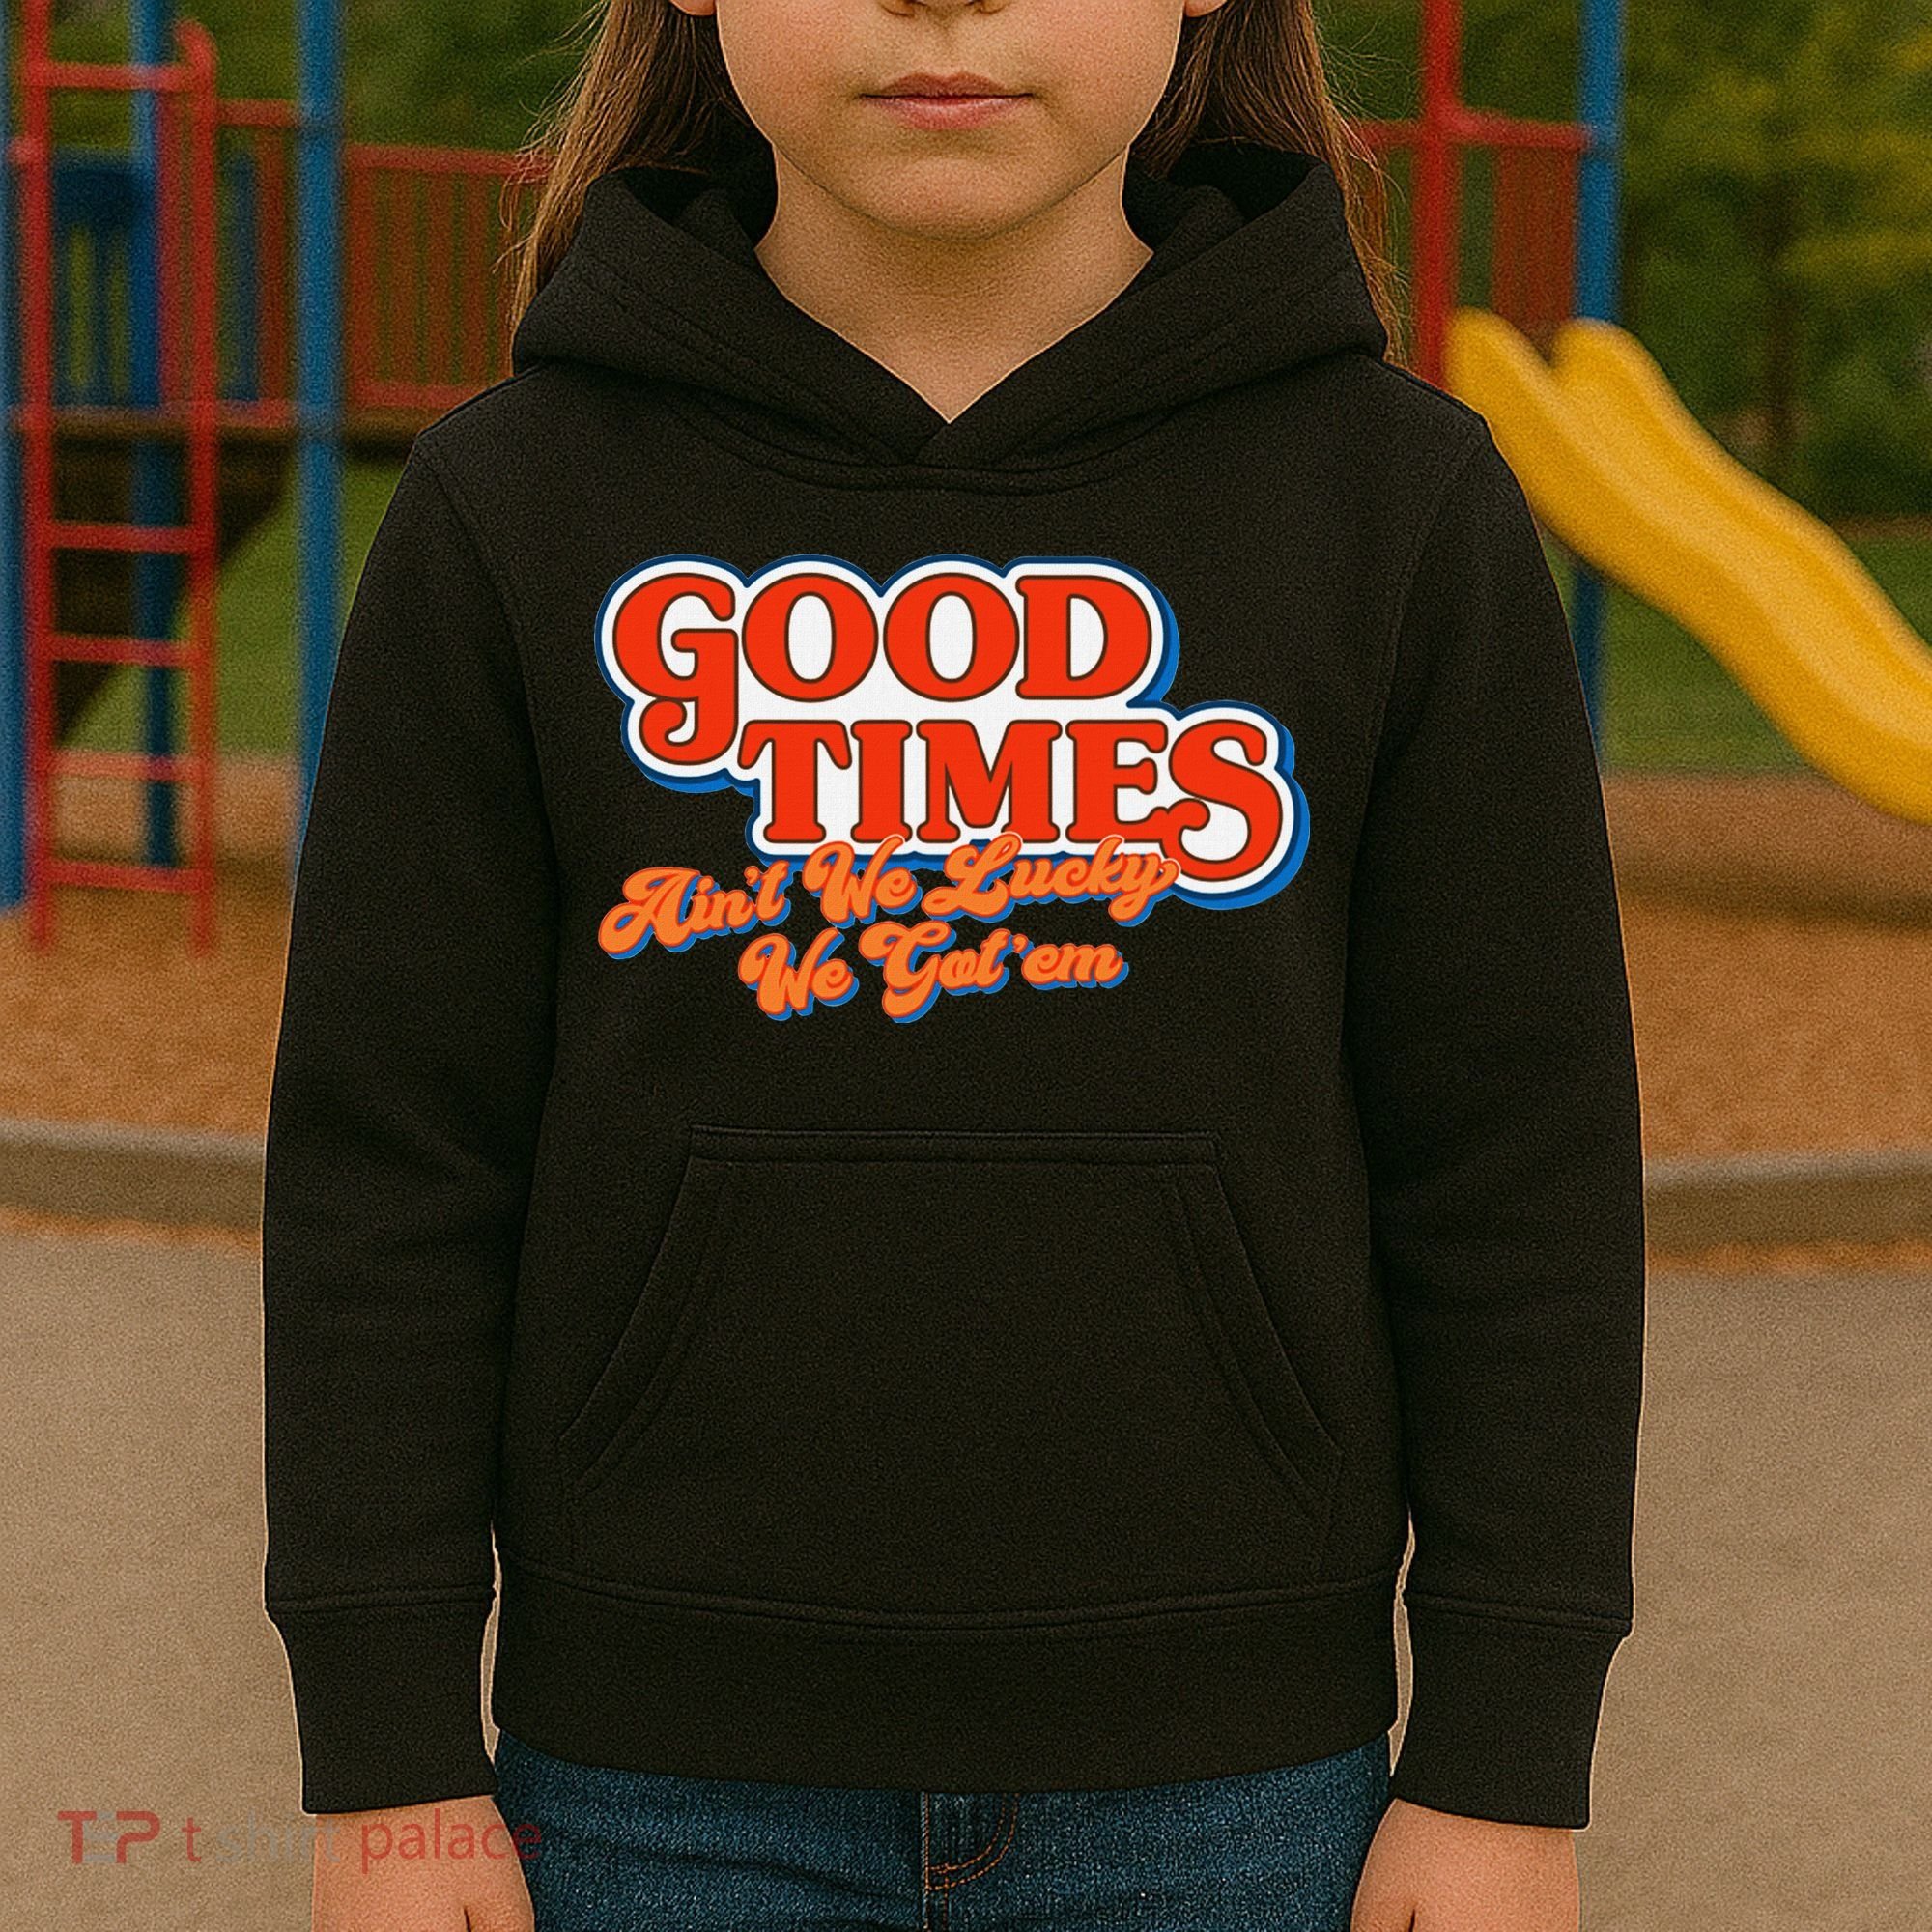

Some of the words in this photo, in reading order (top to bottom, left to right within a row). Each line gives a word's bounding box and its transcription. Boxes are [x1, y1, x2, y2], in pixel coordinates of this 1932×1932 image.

[612, 572, 1152, 765] GOOD
[738, 719, 1283, 881] TIMES
[598, 860, 791, 958] Ain't
[802, 839, 920, 926] We
[922, 833, 1179, 924] Lucky
[738, 927, 857, 1019] We
